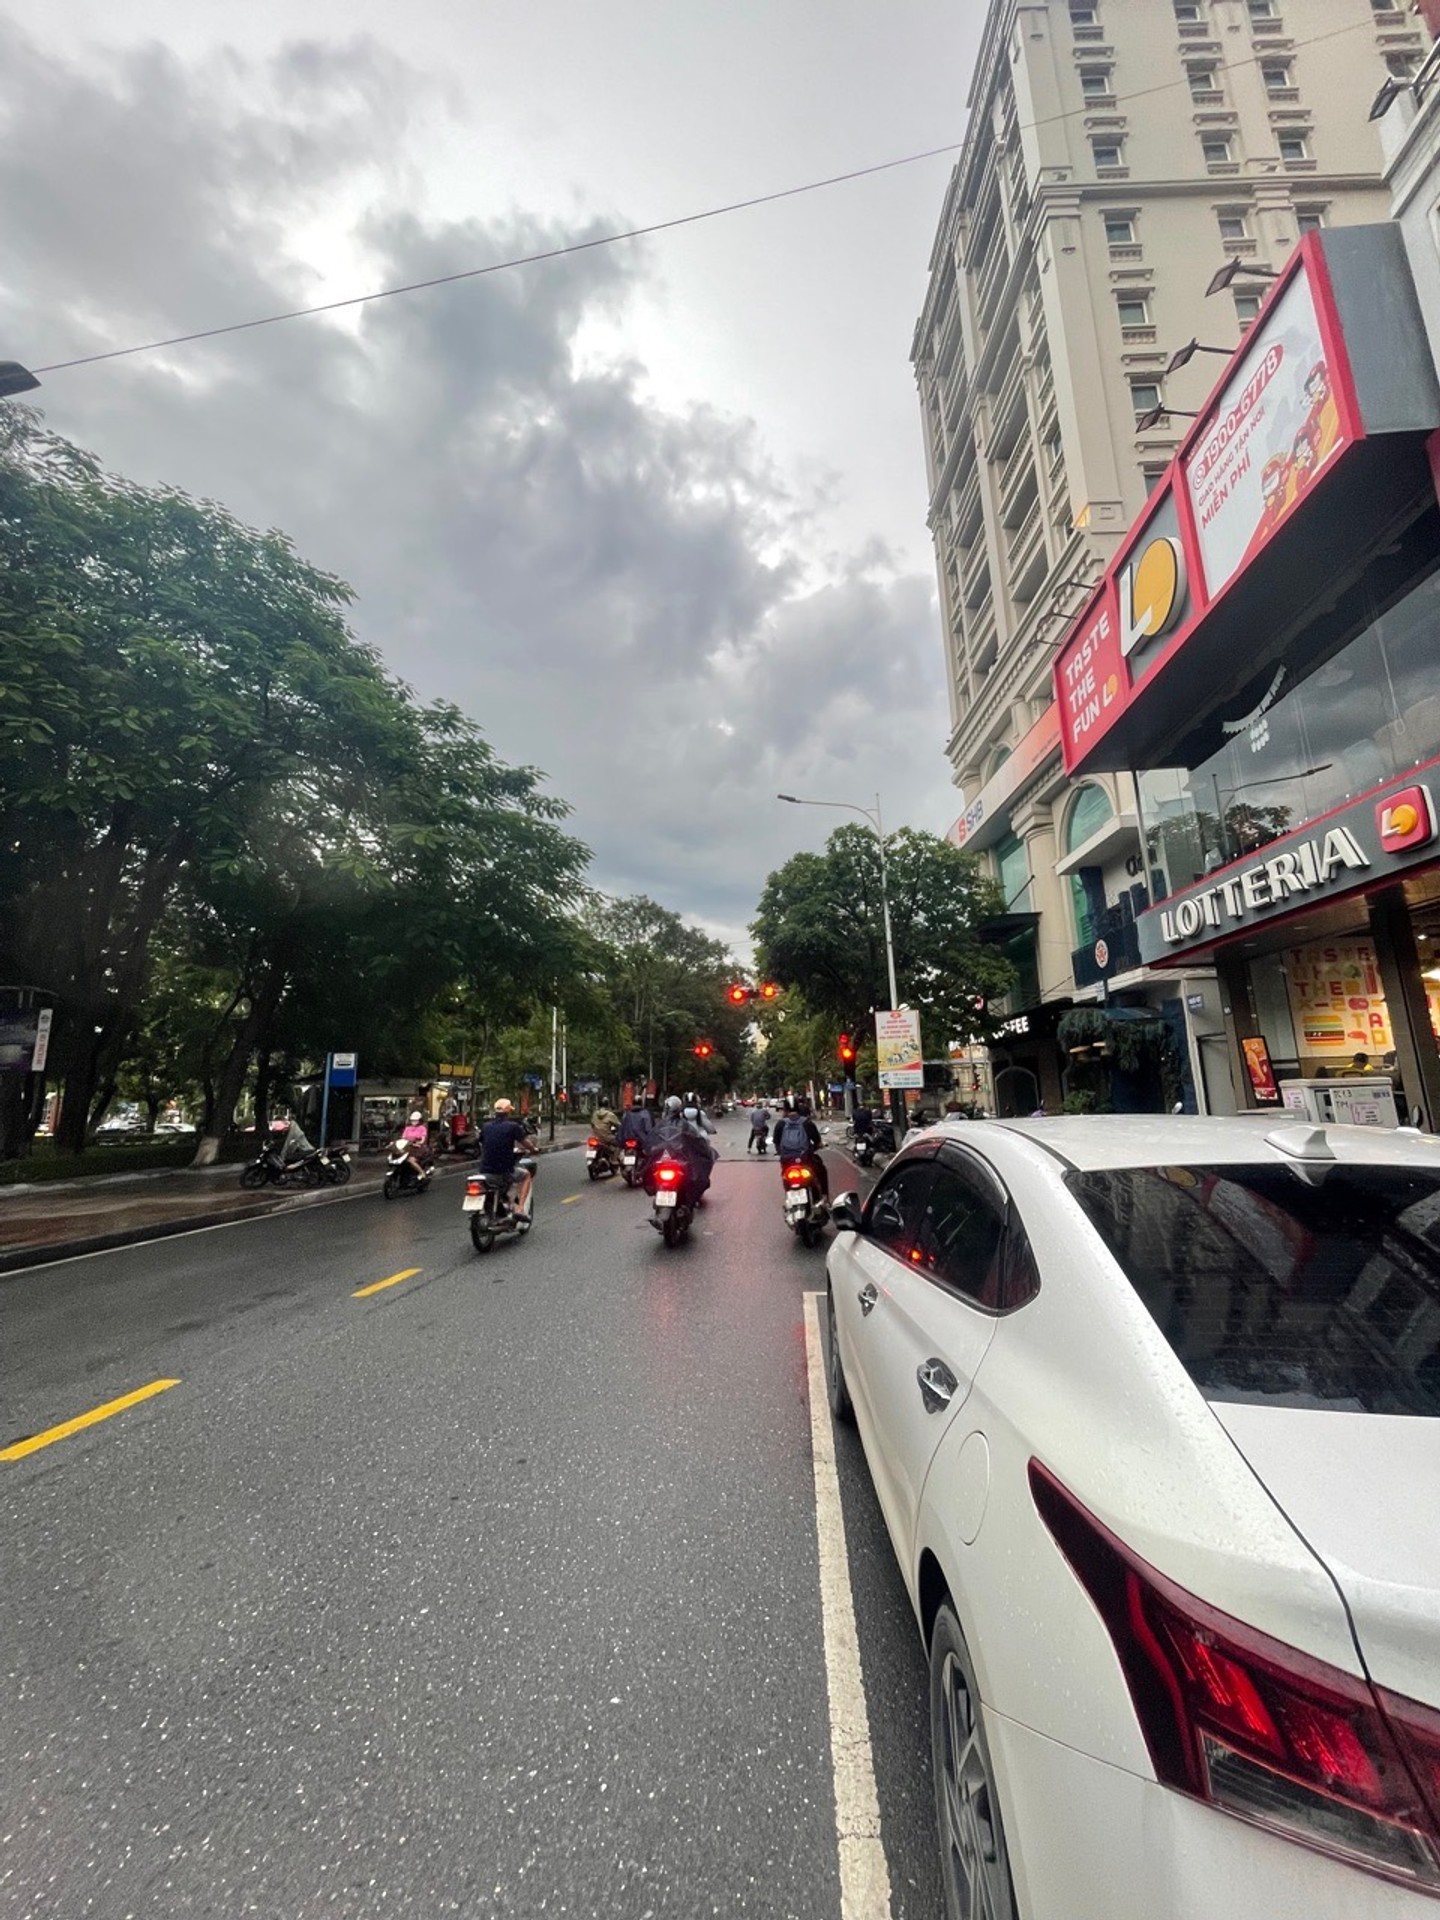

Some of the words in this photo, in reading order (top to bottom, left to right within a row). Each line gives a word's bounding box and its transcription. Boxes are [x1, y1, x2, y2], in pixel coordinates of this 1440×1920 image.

[1205, 349, 1278, 468] 1900-6778
[1198, 482, 1215, 507] GIAO
[1200, 483, 1229, 530] MIỄN
[1229, 447, 1251, 490] PHÍ
[1065, 610, 1110, 687] TASTE
[1069, 668, 1096, 714] THE
[1072, 695, 1101, 744] FUN
[966, 799, 984, 833] SHB
[1159, 826, 1371, 944] LOTTERIA
